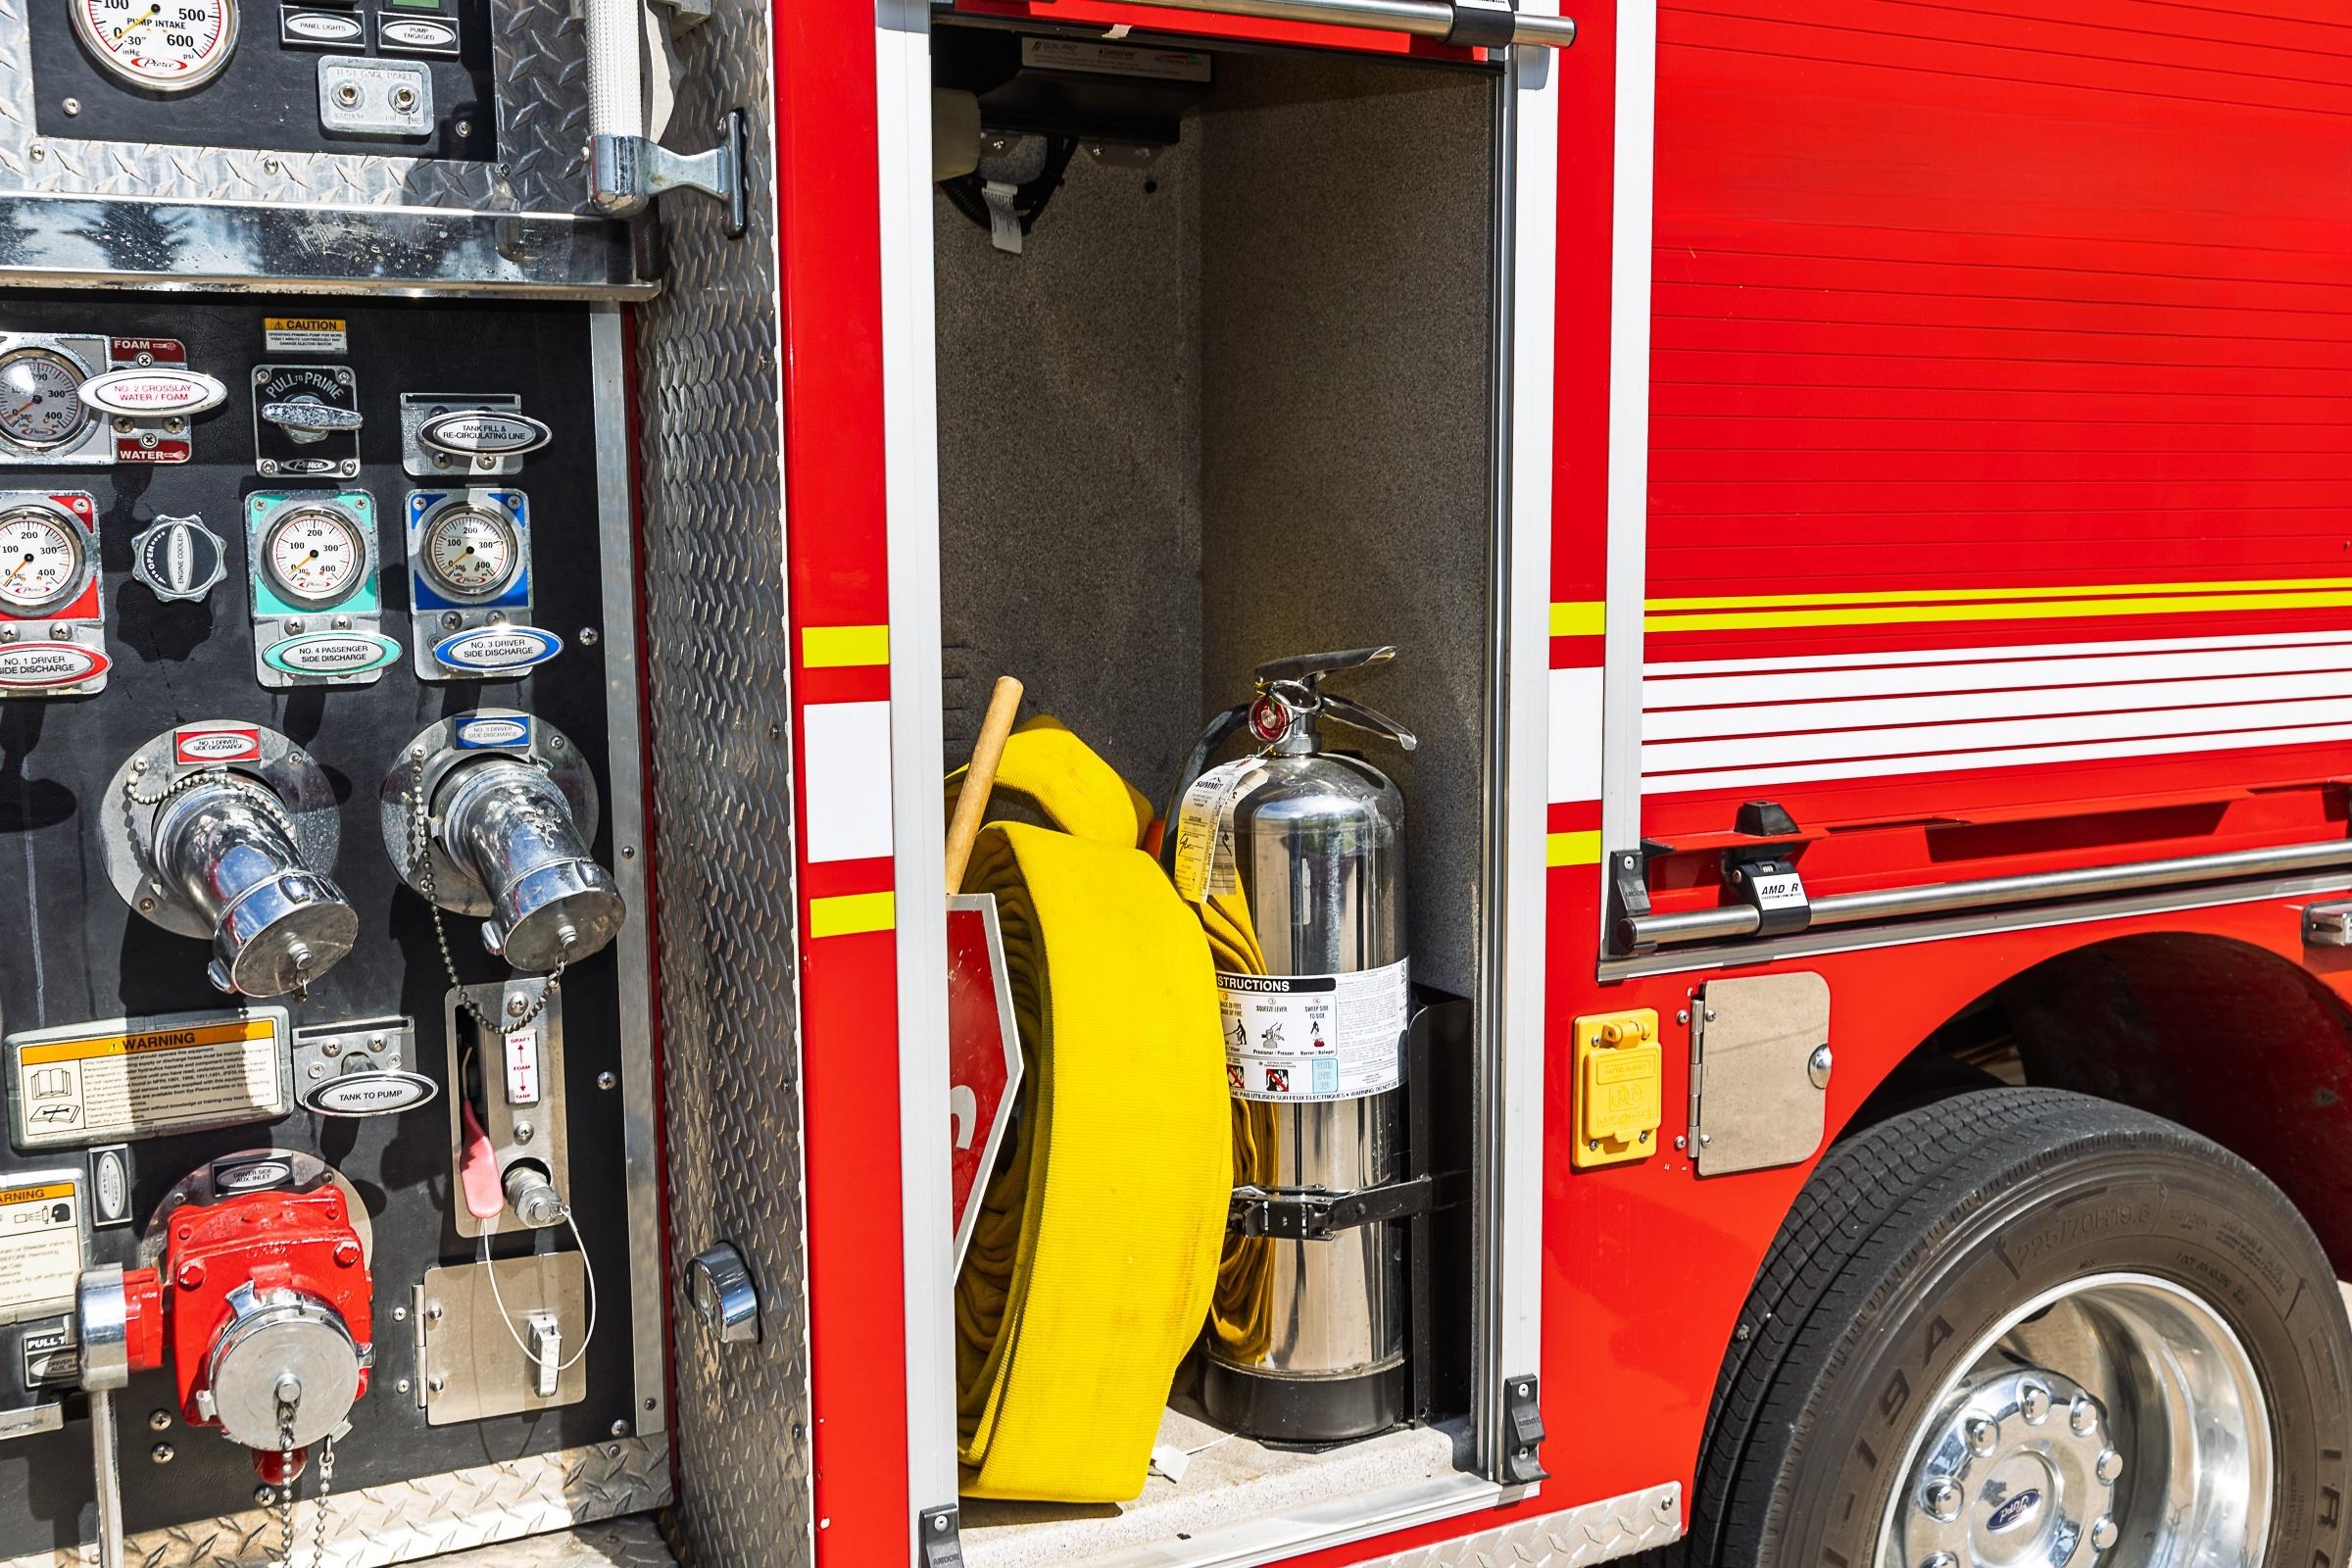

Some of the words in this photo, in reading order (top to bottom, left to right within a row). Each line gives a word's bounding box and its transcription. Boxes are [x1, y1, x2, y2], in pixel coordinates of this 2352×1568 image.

[178, 8, 206, 22] 500
[126, 17, 153, 25] PUMP
[155, 20, 186, 29] INTAKE
[114, 26, 122, 39] 0
[167, 33, 194, 47] 600
[144, 57, 174, 69] Pierce
[286, 320, 337, 330] CAUTION
[114, 340, 150, 349] FOAM
[265, 373, 298, 399] PULL
[304, 371, 345, 400] PRIME
[120, 450, 165, 461] WATER
[146, 545, 155, 570] OPEN
[321, 645, 368, 654] PASSENGER
[495, 639, 525, 648] DRIVER
[485, 647, 533, 657] DISCHARGE
[31, 656, 66, 664] DRIVER
[20, 664, 74, 674] DISCHARGE
[1195, 780, 1224, 791] SUMMIT
[1761, 884, 1786, 896] AMD
[1791, 882, 1799, 893] R
[1217, 976, 1291, 992] STRUCTIONS
[122, 1032, 195, 1051] WARNING
[339, 1092, 362, 1102] TANK
[377, 1090, 403, 1100] PUMP
[27, 1337, 59, 1349] PULL
[932, 1552, 960, 1566] AMDOR
